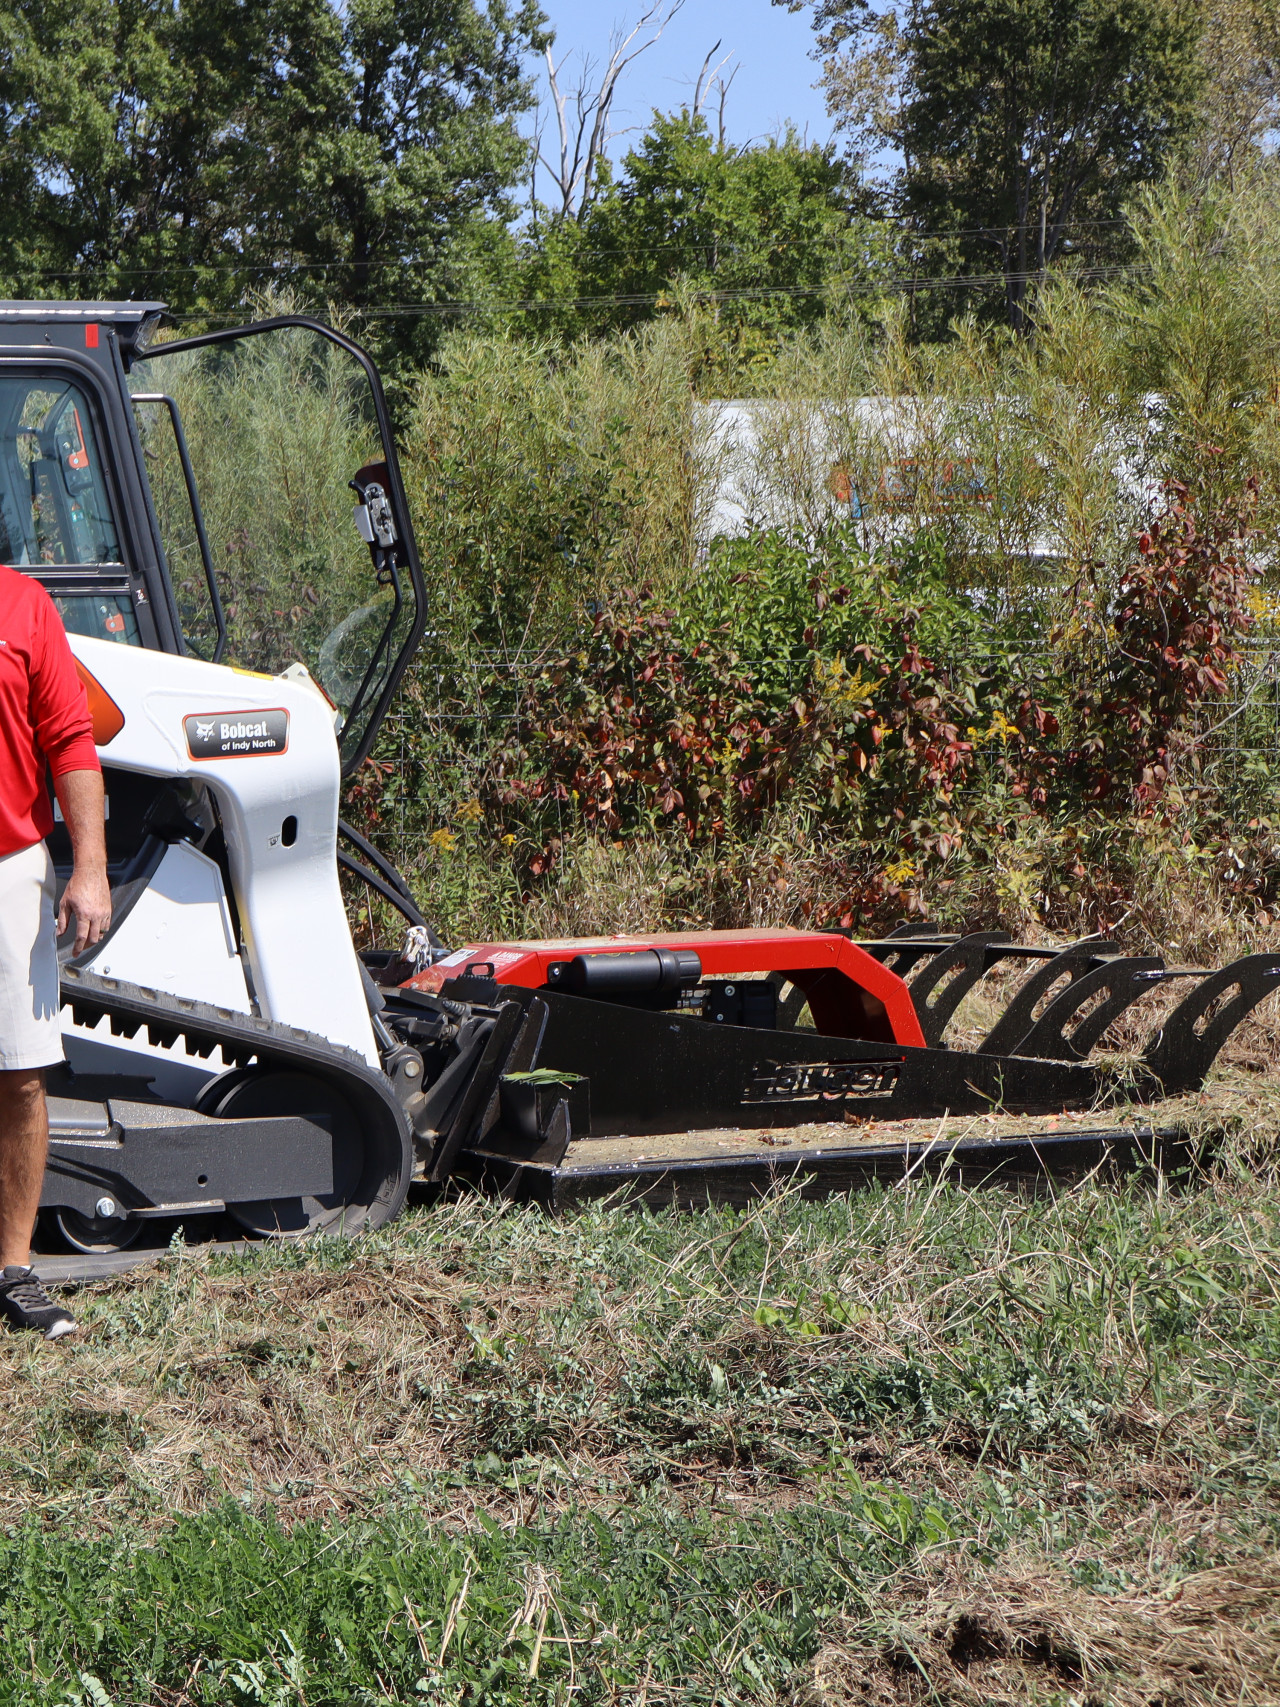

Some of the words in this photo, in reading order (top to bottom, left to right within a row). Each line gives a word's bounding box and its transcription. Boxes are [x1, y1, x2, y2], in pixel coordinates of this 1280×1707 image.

[220, 721, 268, 740] Bobcat
[221, 742, 231, 751] of
[232, 740, 251, 751] Indy
[252, 739, 276, 749] North
